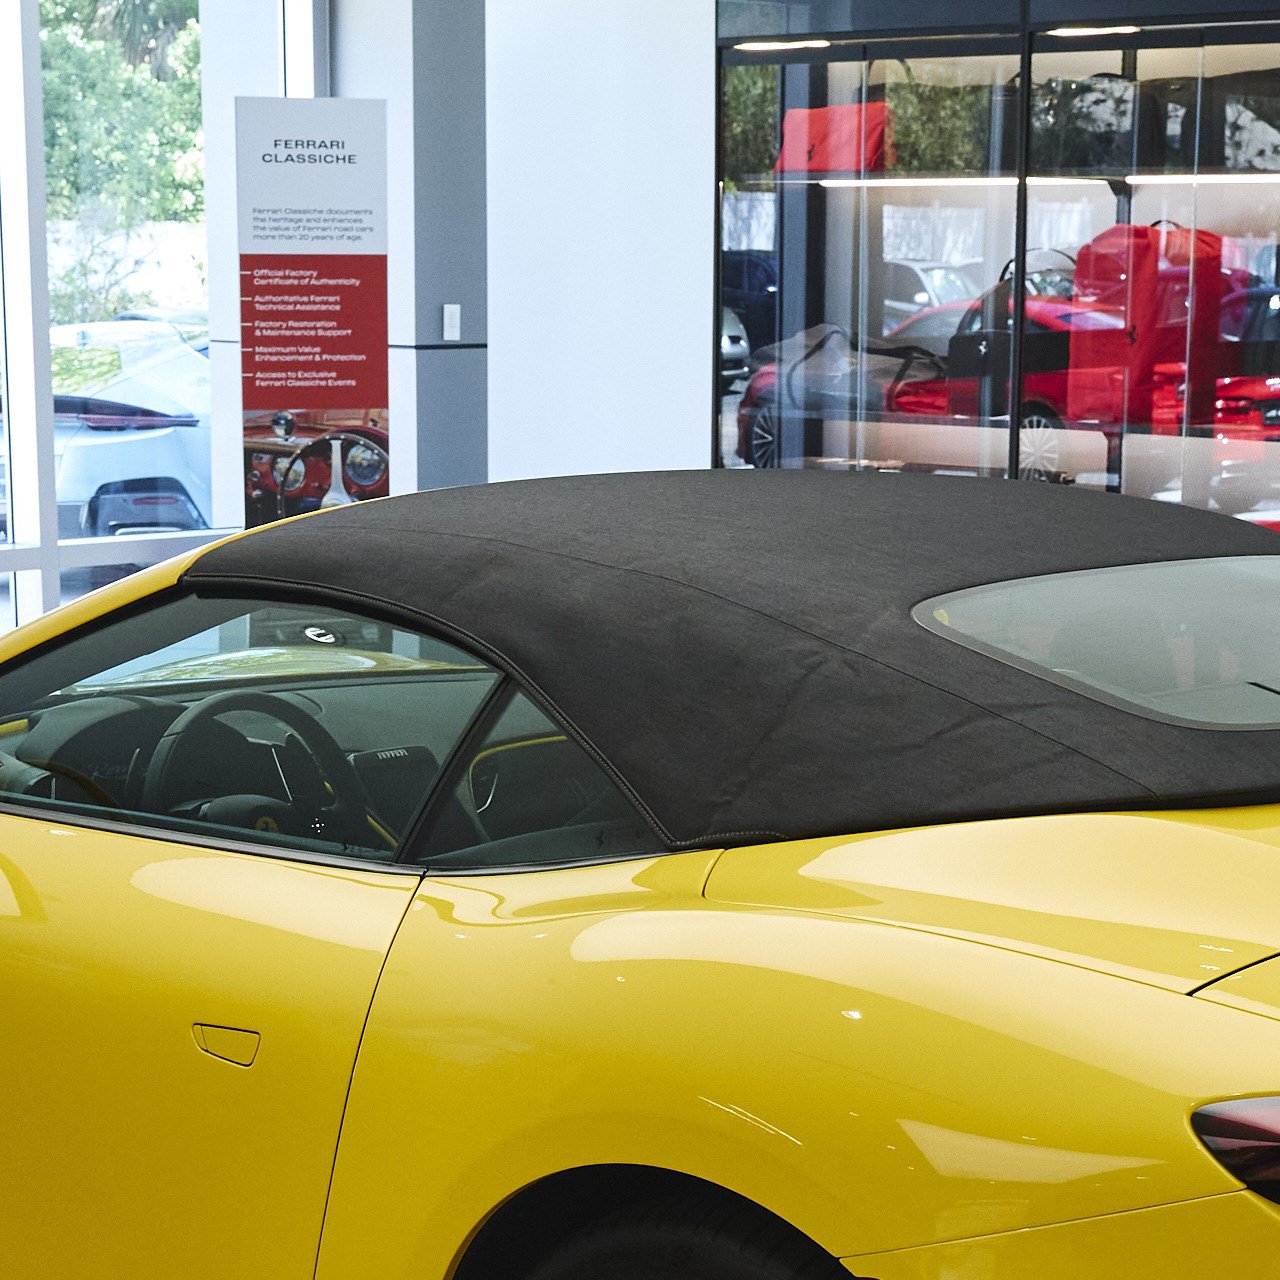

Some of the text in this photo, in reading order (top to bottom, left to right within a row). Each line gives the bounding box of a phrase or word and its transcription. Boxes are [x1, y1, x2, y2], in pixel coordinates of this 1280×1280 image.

[273, 139, 345, 149] FERRARI
[261, 153, 357, 164] CLASSICHE
[252, 207, 373, 215] Ferrari Classiche documents
[268, 217, 304, 225] heritage
[253, 269, 318, 278] Official Factory
[254, 278, 361, 287] Certificate of Authenticity
[255, 303, 341, 311] Technical Assistance
[254, 320, 337, 329] Factory Restoration
[317, 329, 352, 337] Support
[256, 379, 357, 387] Ferrari Classiche Events
